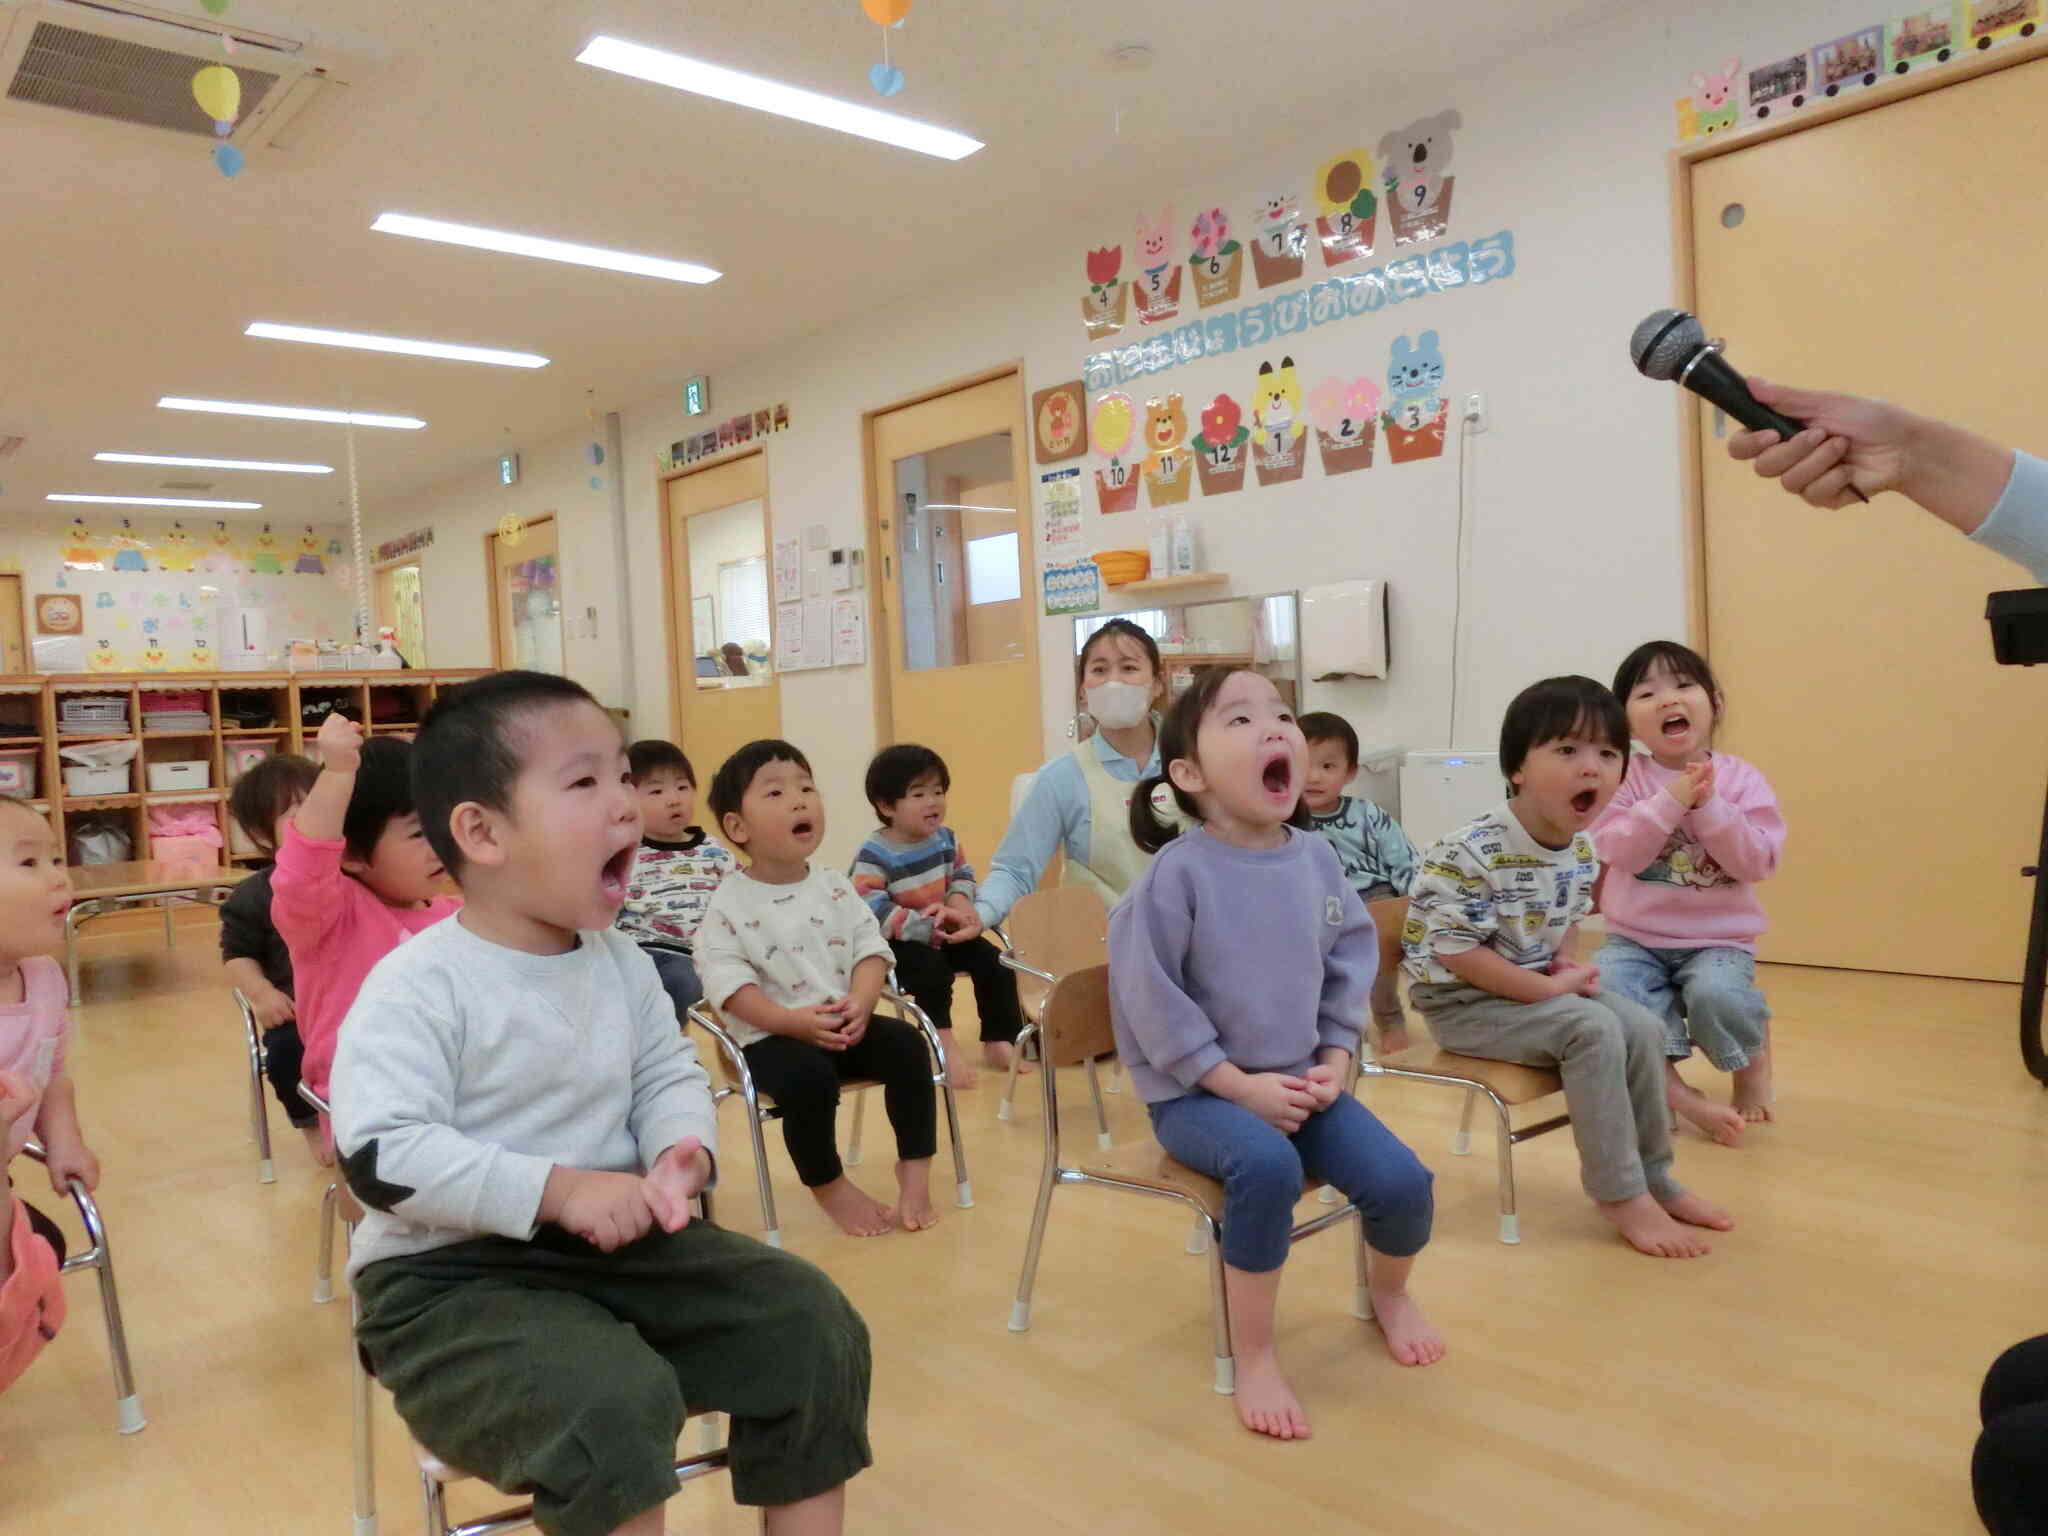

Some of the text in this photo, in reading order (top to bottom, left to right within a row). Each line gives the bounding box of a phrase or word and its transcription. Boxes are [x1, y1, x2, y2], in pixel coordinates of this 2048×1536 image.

[1414, 184, 1427, 207] 9
[1341, 213, 1353, 233] 8
[1272, 233, 1283, 252] 7
[1210, 256, 1220, 274] 6
[1151, 273, 1161, 291] 5
[1100, 290, 1109, 308] 4
[1408, 405, 1420, 429] 3
[1340, 418, 1355, 437] 2
[1274, 432, 1282, 453] 1
[1212, 443, 1231, 465] 12
[1160, 455, 1174, 474] 11
[1111, 466, 1125, 486] 10
[98, 639, 110, 649] 10
[148, 638, 158, 649] 11
[196, 639, 207, 648] 12
